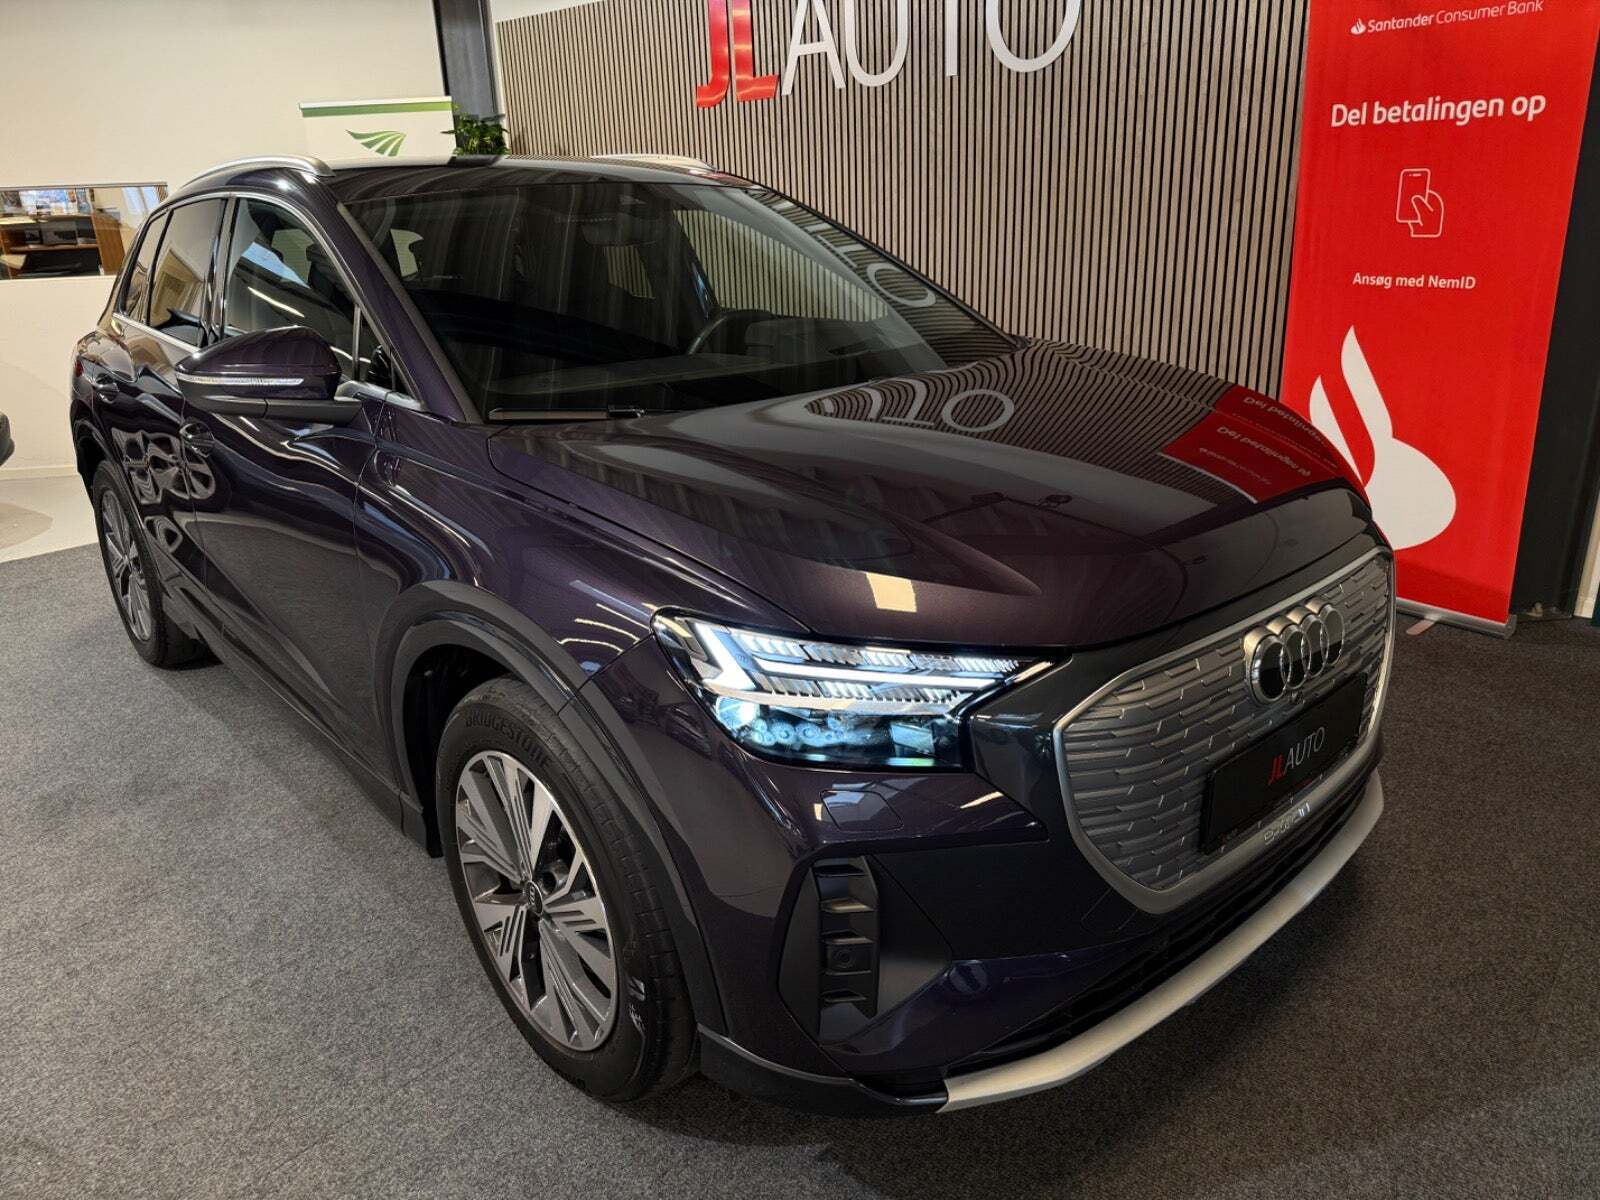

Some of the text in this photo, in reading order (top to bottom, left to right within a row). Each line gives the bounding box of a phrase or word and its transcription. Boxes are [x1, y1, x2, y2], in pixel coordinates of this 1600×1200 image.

[1367, 0, 1544, 33] Santander Consumer Bank
[1331, 94, 1547, 127] Del betalingen op
[1352, 271, 1476, 289] Ansøg med NemID
